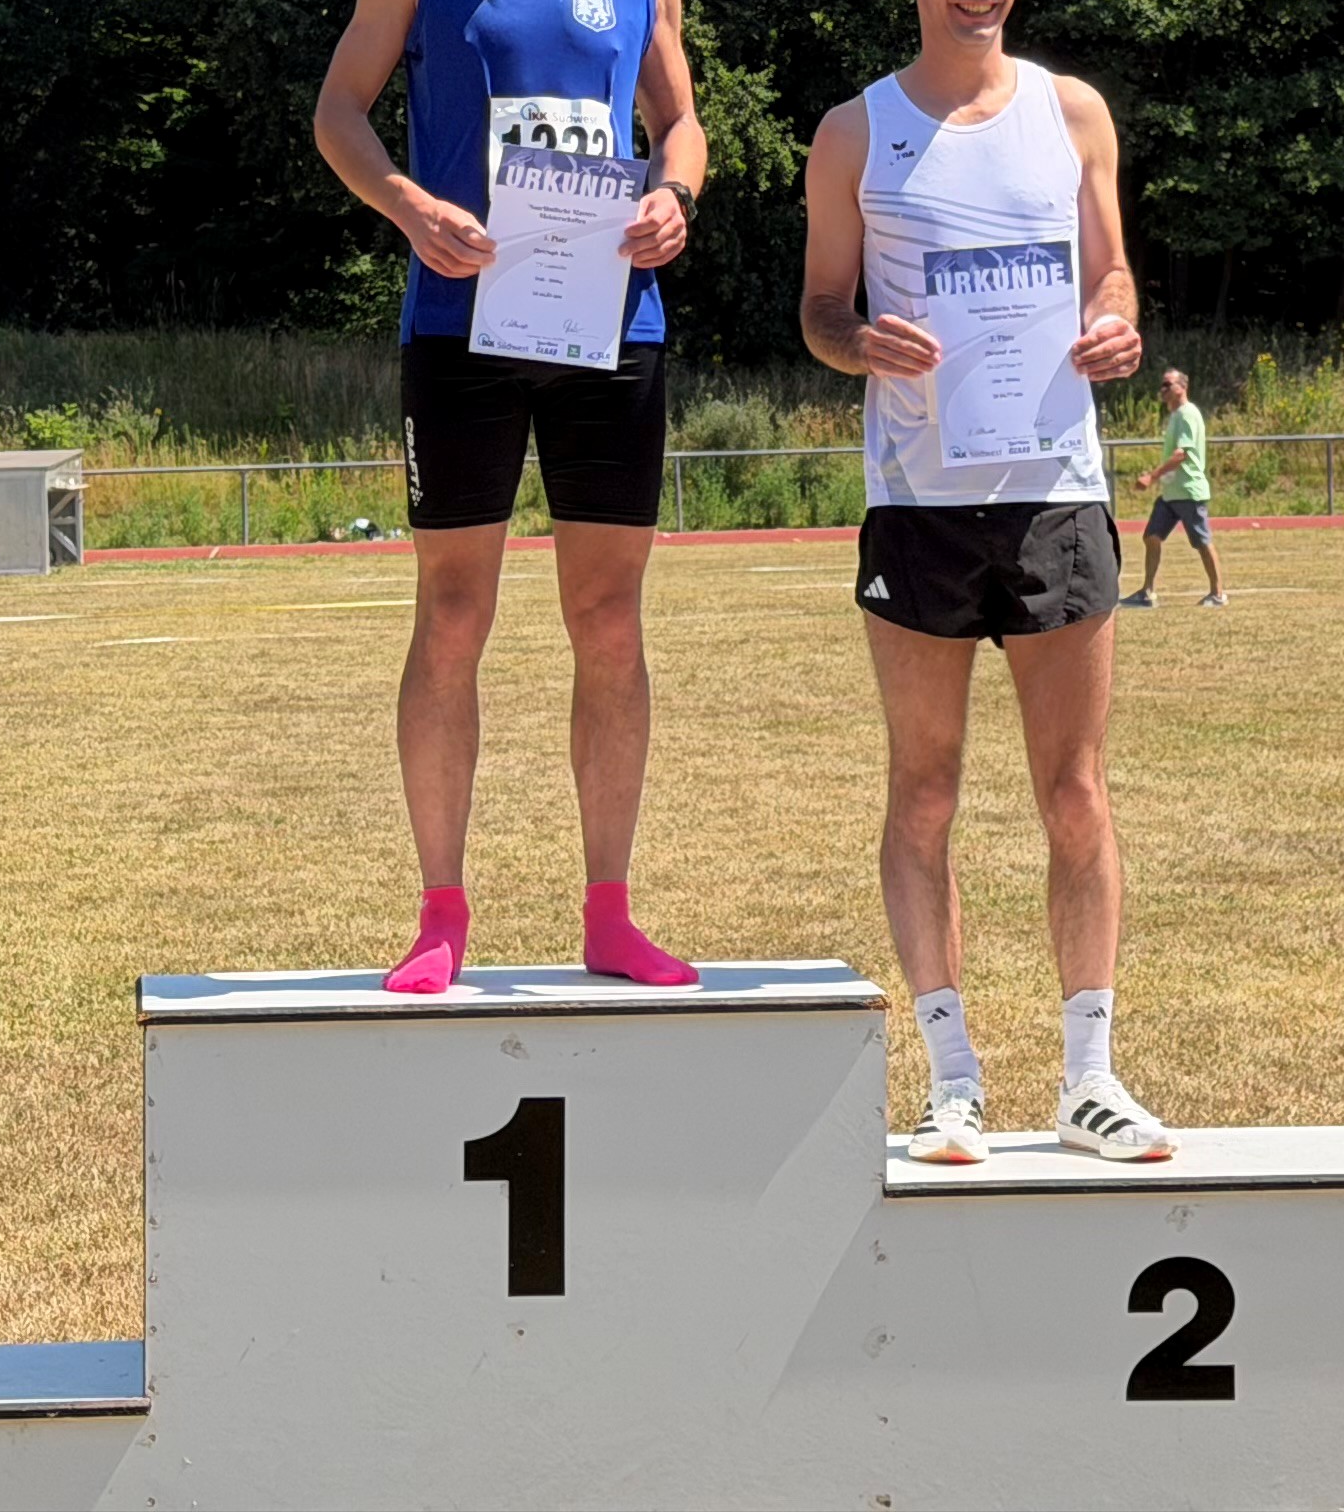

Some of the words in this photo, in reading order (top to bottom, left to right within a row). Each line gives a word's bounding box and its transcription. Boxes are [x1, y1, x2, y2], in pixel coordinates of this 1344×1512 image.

[506, 165, 636, 201] URKUNDE
[935, 262, 1066, 296] URKUNDE
[405, 416, 420, 489] CRAFT
[464, 1096, 565, 1297] 1
[1126, 1256, 1236, 1401] 2
